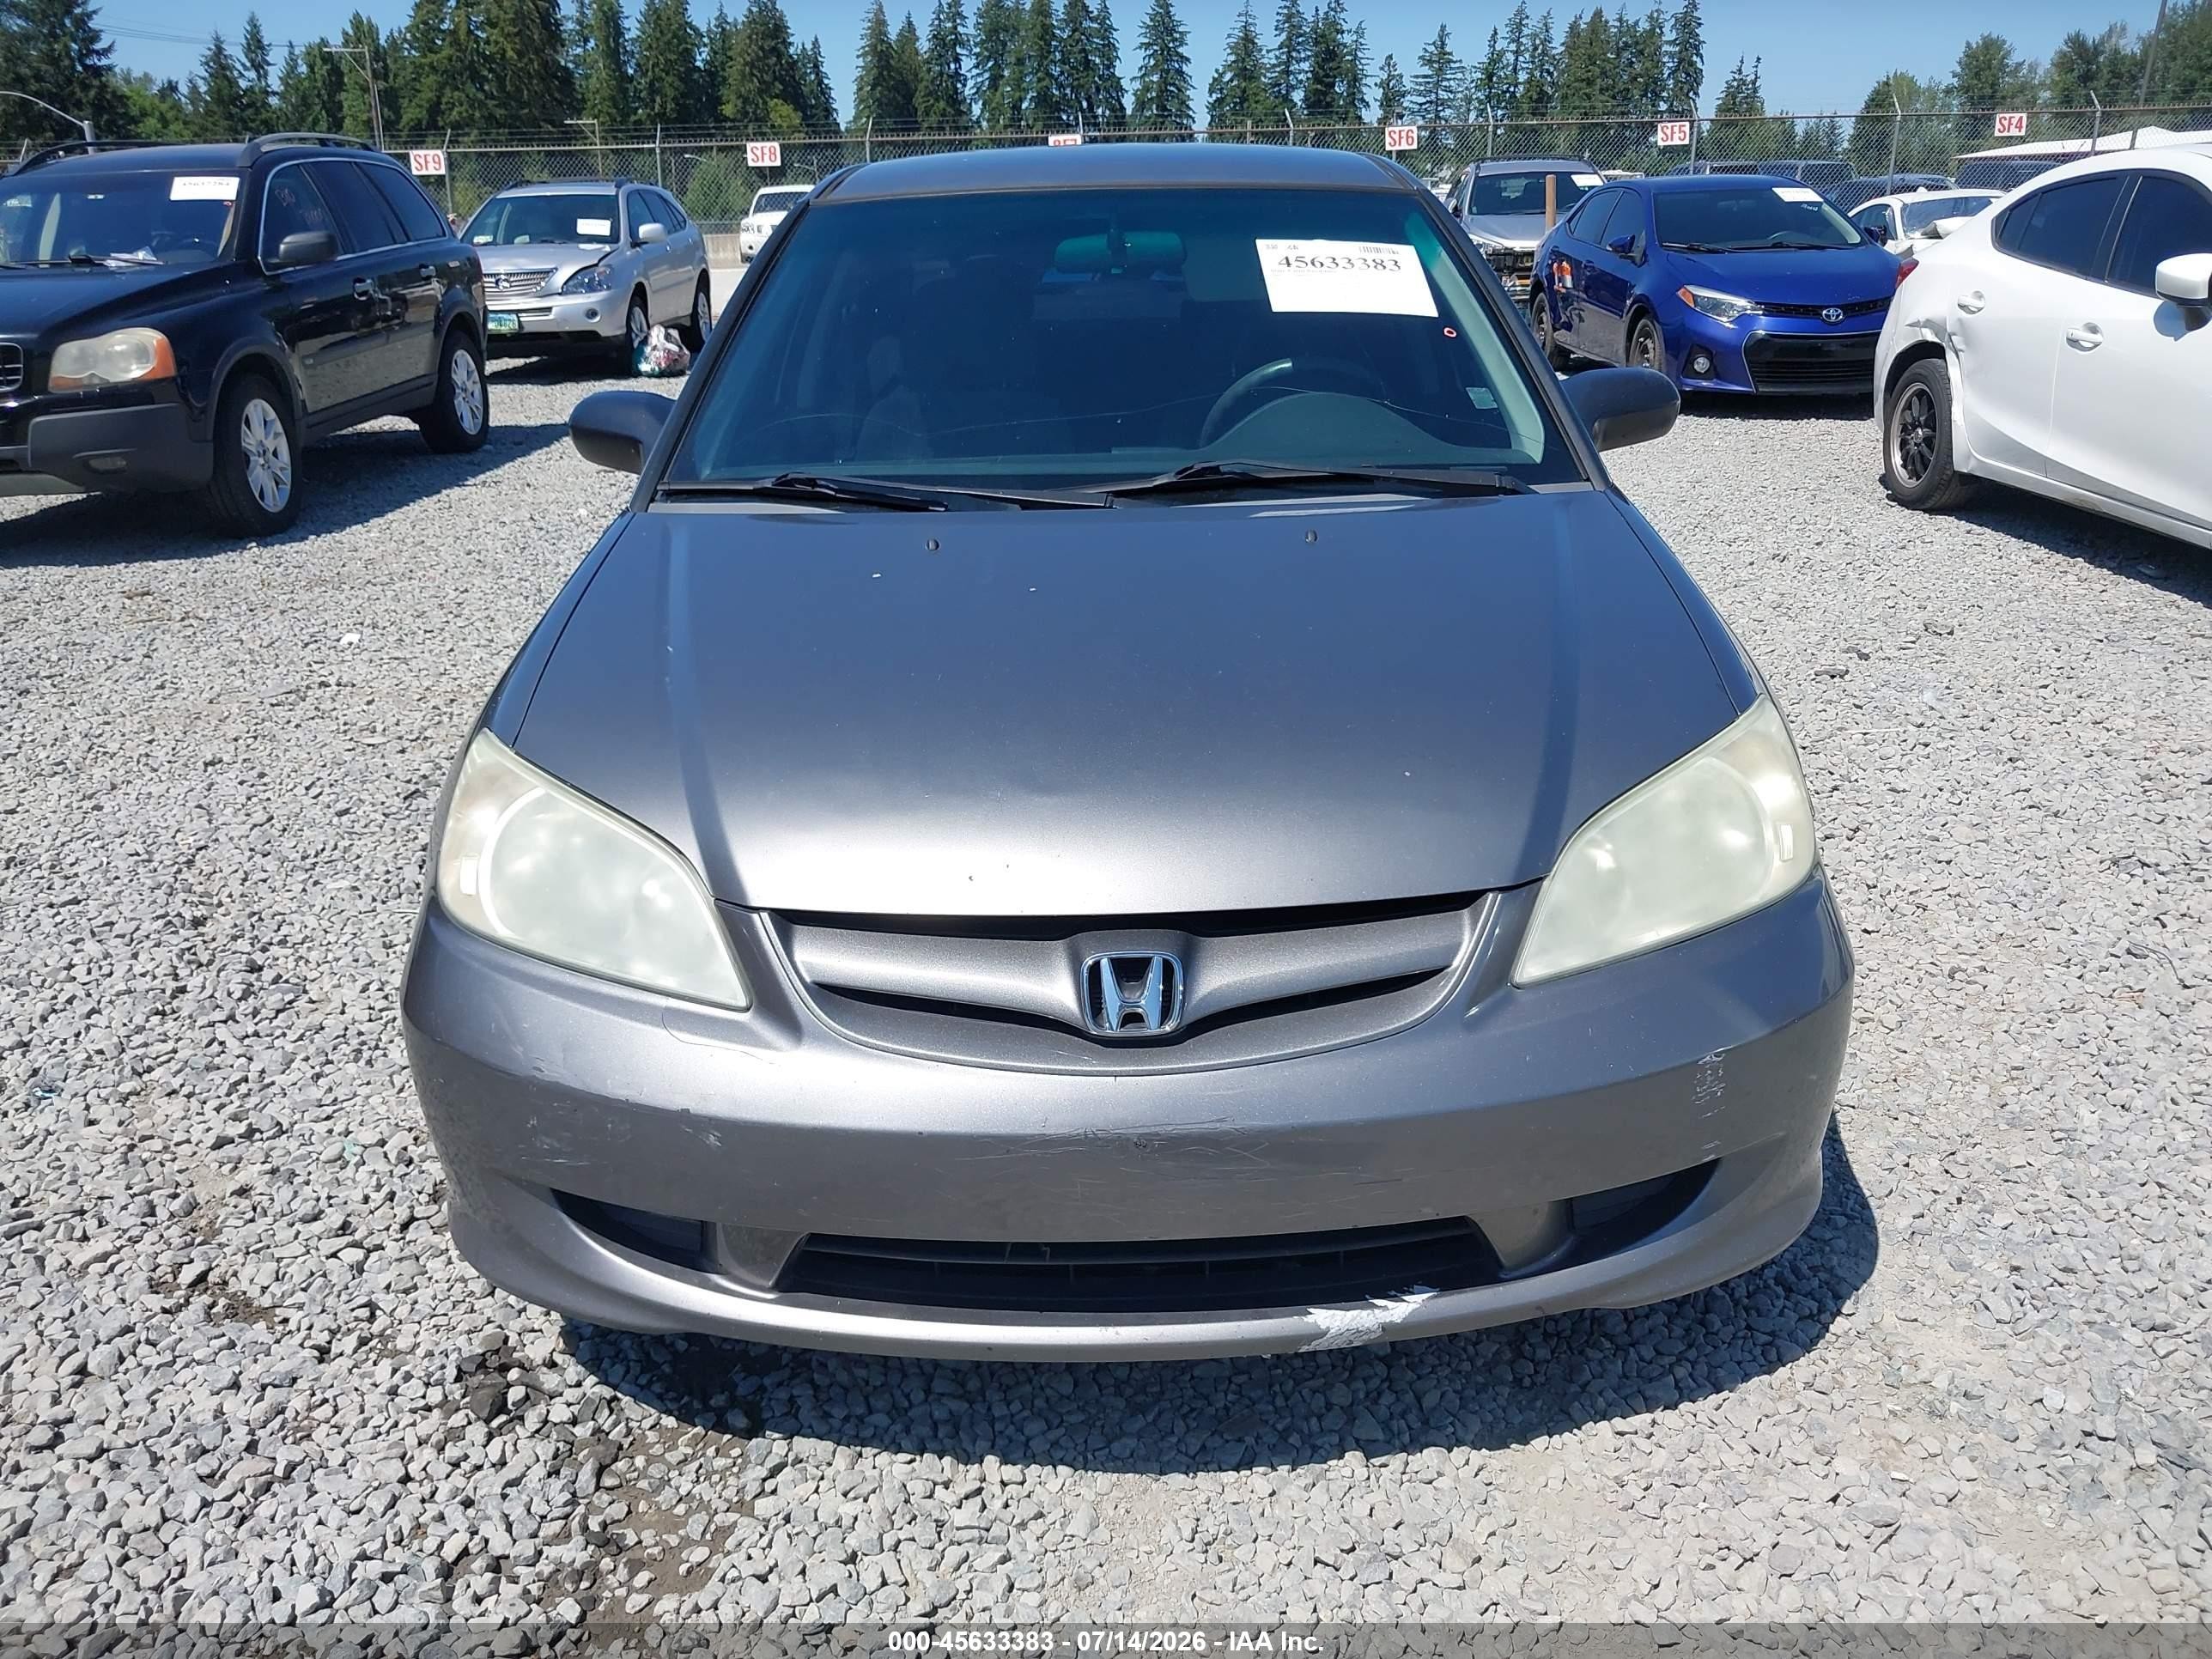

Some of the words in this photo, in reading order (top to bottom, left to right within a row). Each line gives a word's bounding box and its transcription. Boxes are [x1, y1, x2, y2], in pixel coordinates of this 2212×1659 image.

[1660, 124, 1686, 142] SF5
[1997, 116, 2024, 133] SF4
[1388, 129, 1414, 147] SF6
[414, 153, 441, 172] SF9
[750, 145, 777, 163] SF8
[1278, 256, 1401, 271] 45633383
